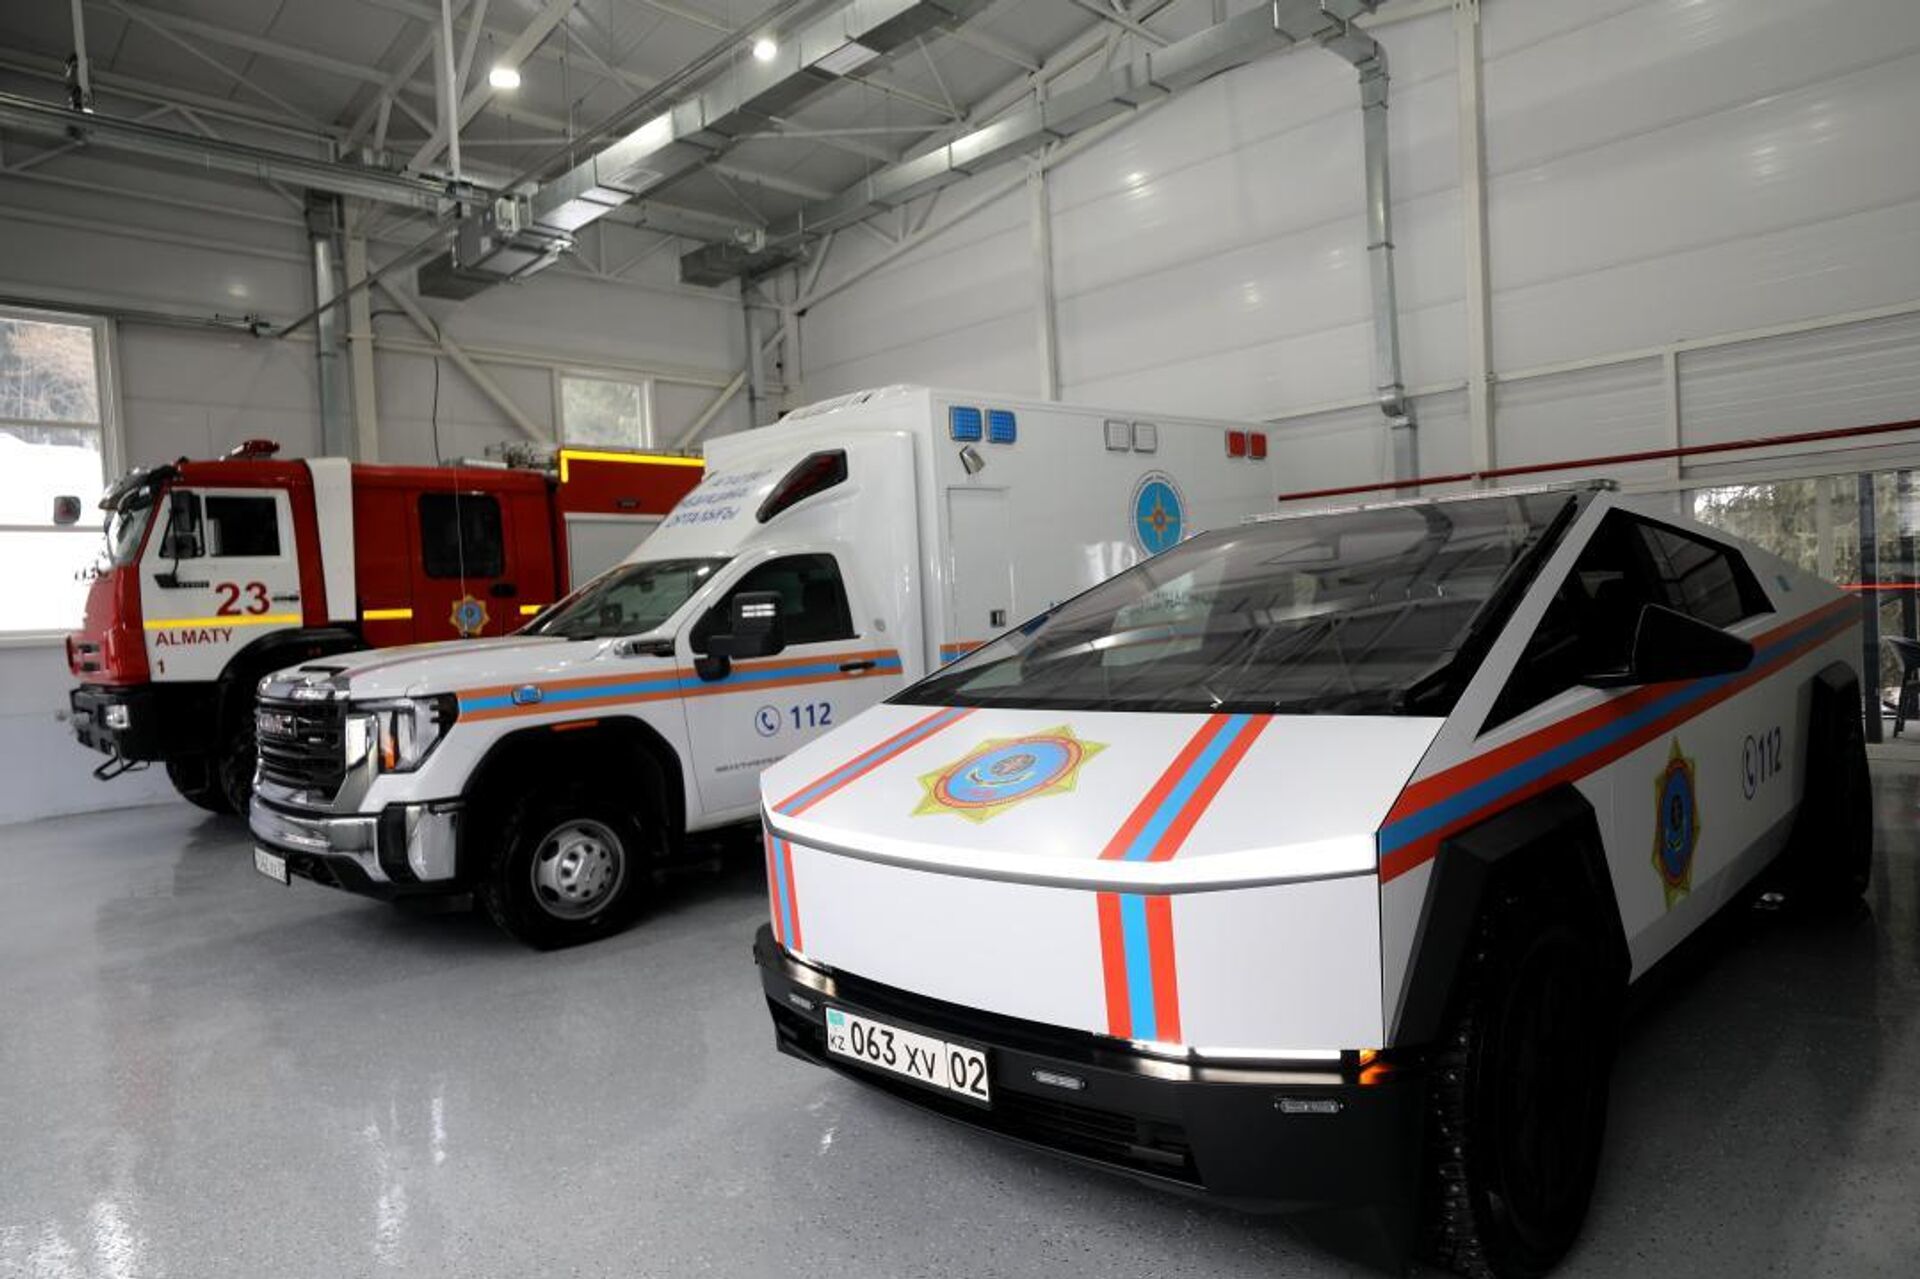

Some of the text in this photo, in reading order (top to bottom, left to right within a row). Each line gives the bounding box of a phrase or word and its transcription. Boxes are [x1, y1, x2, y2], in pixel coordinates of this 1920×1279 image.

[215, 582, 270, 616] 23
[155, 626, 234, 647] ALMATY
[157, 658, 165, 674] 1
[790, 702, 832, 730] 112
[1758, 725, 1782, 784] 112
[829, 1035, 846, 1051] KZ
[850, 1020, 988, 1097] 063 XV 02
